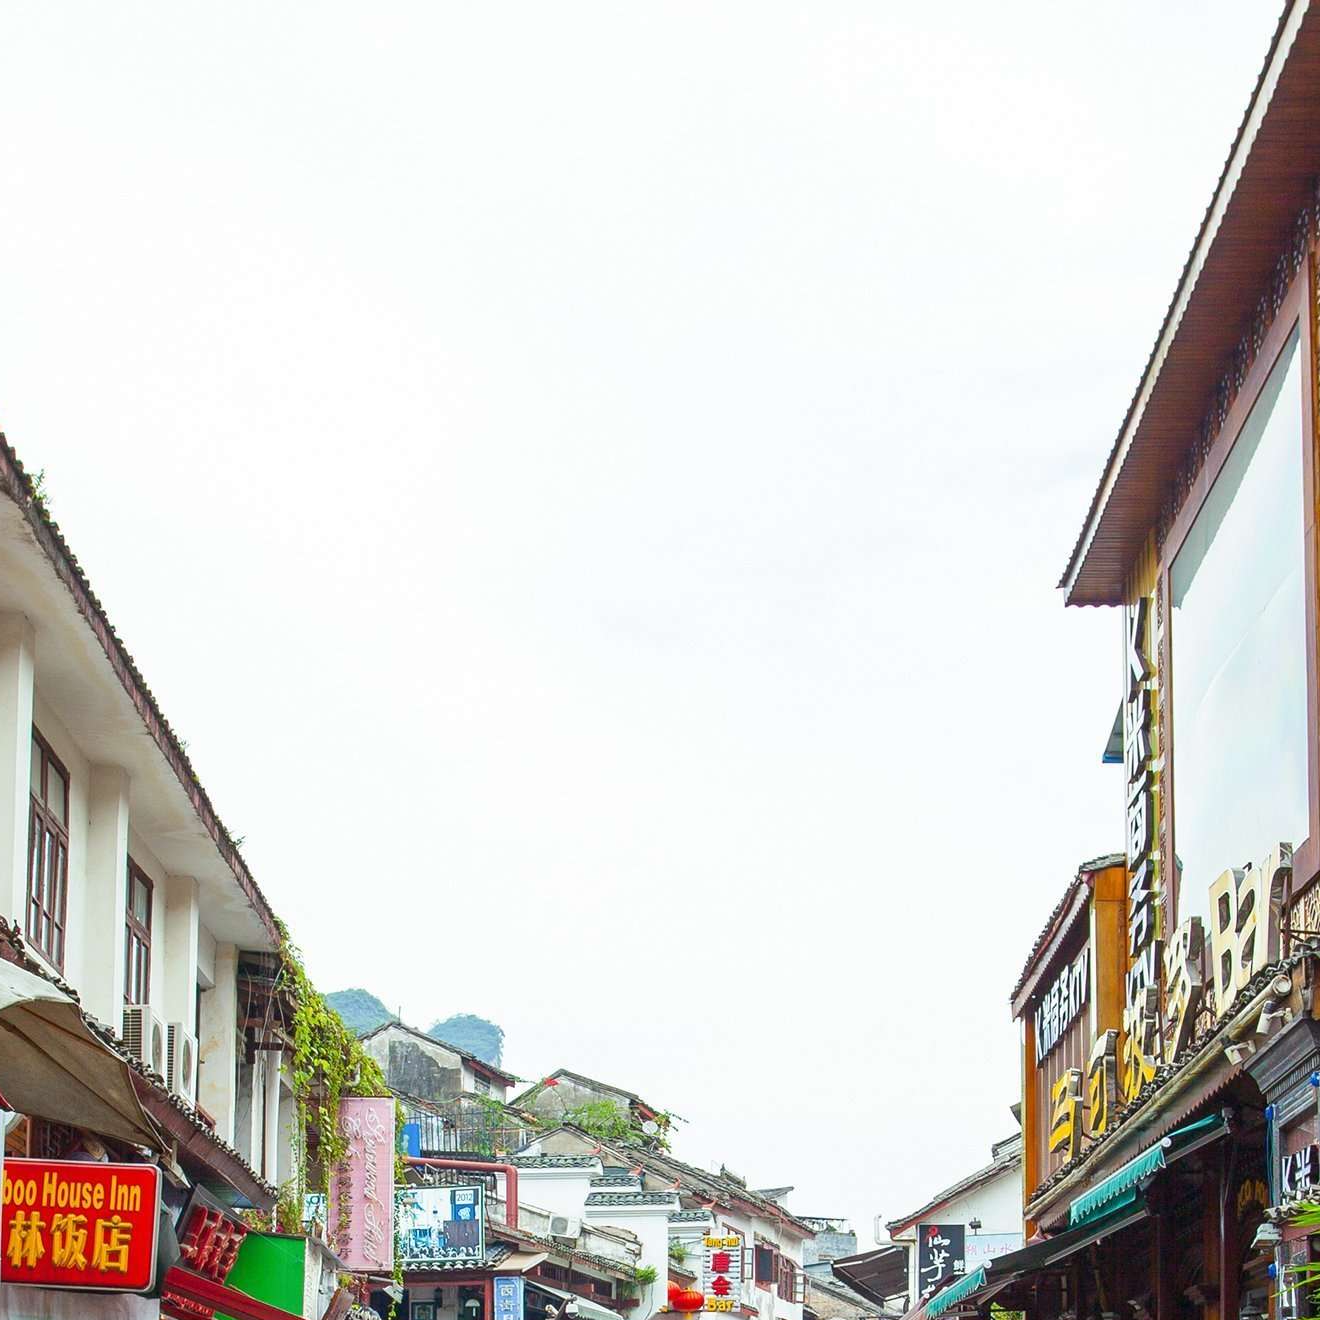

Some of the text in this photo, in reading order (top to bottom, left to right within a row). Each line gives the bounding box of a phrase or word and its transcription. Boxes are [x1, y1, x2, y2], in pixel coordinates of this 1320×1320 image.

[1209, 843, 1293, 1020] Bar
[41, 1171, 105, 1210] House
[109, 1175, 141, 1212] Inn
[706, 1300, 735, 1312] Bar
